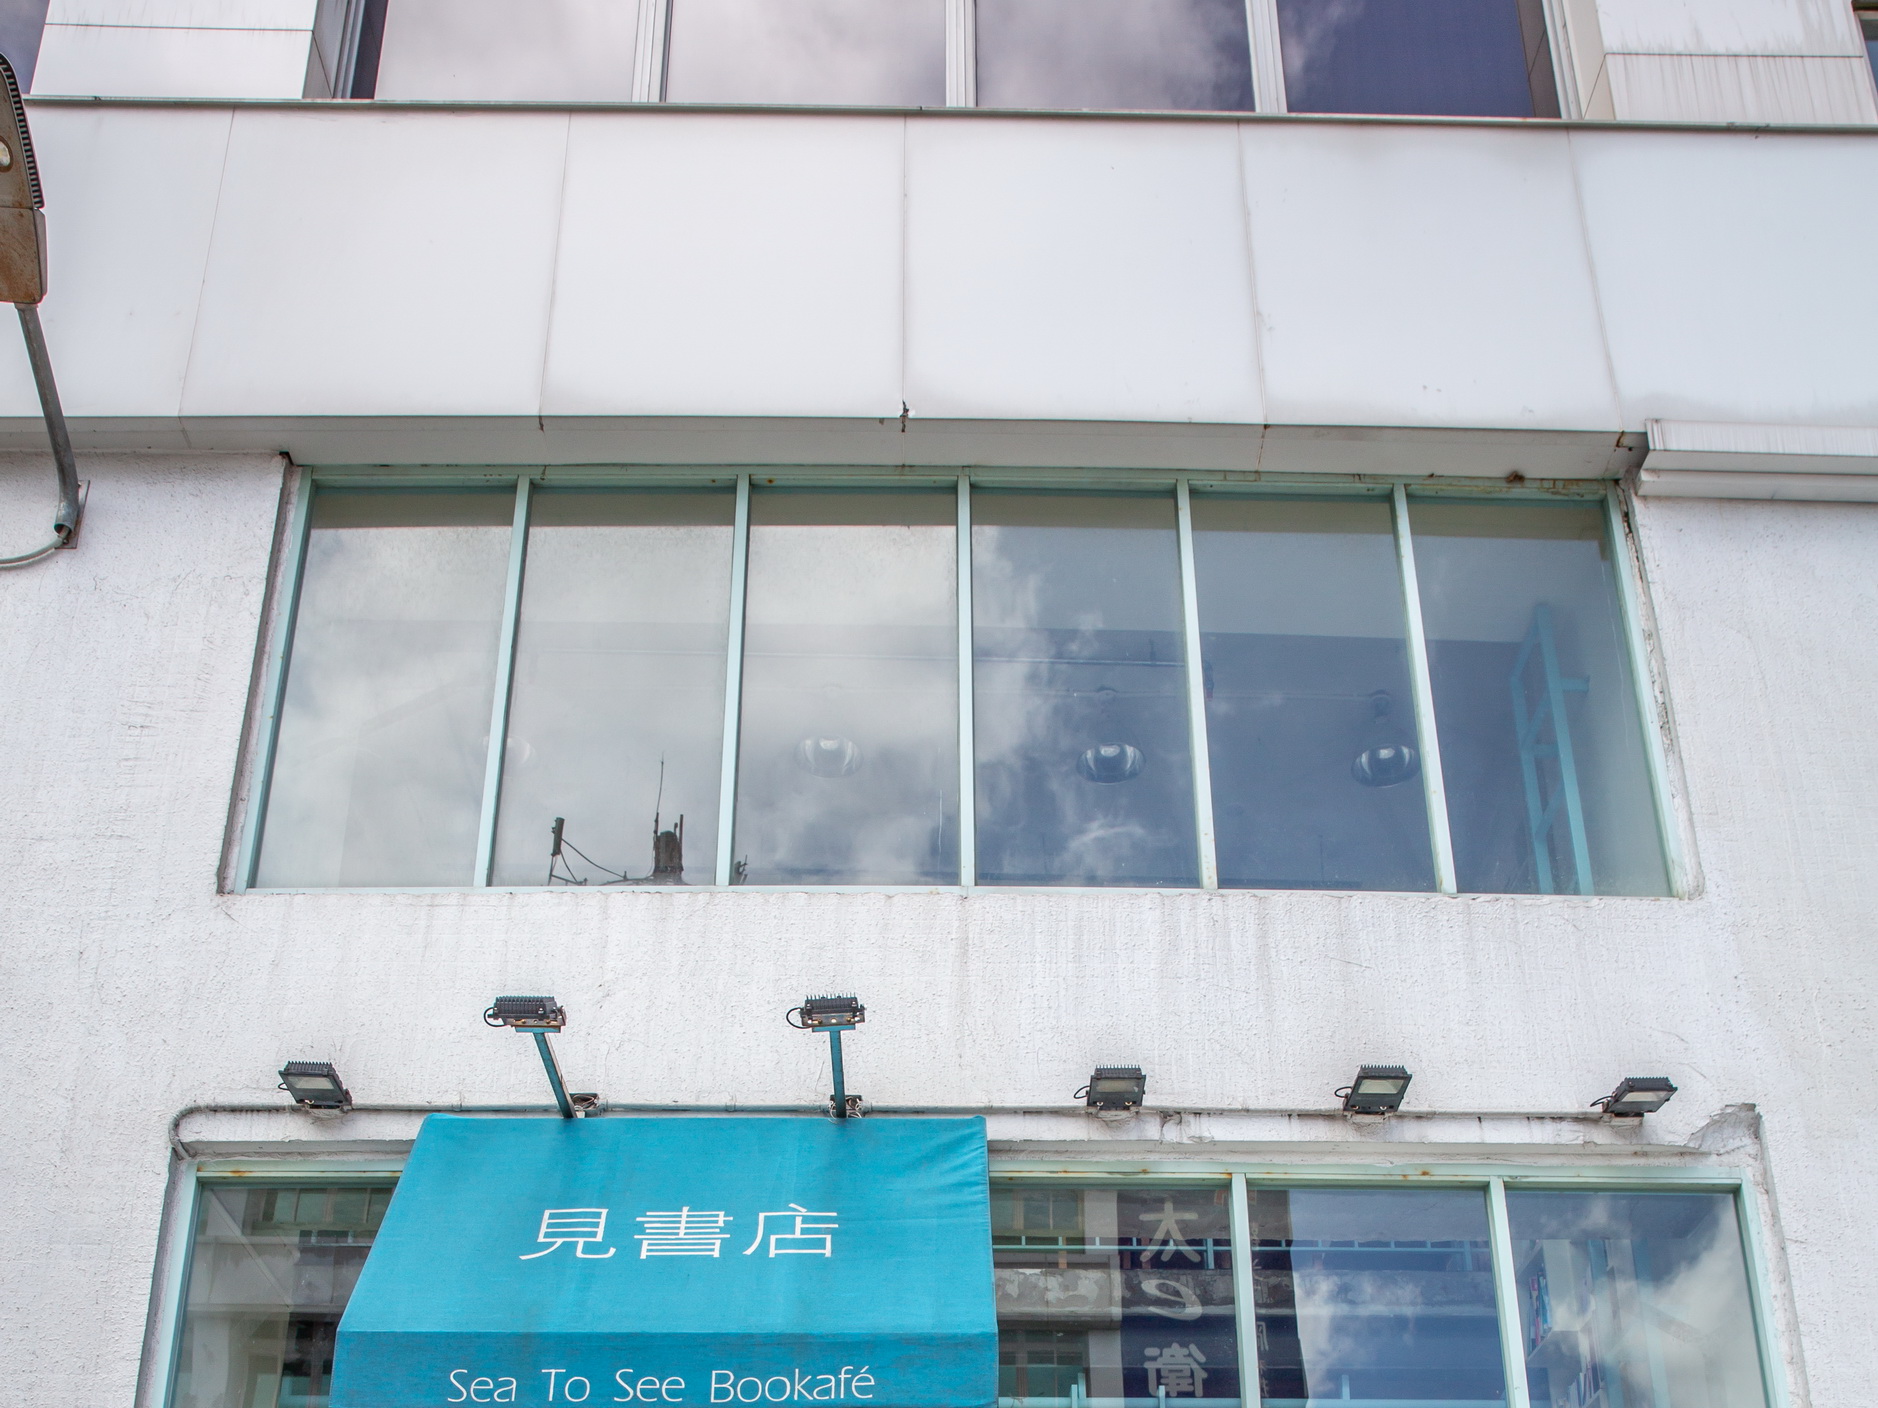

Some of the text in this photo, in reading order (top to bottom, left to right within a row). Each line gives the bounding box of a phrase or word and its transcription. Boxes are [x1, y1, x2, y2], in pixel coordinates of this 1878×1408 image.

[519, 1203, 839, 1260] 見書店
[447, 1366, 875, 1403] Sea To See Bookafé
